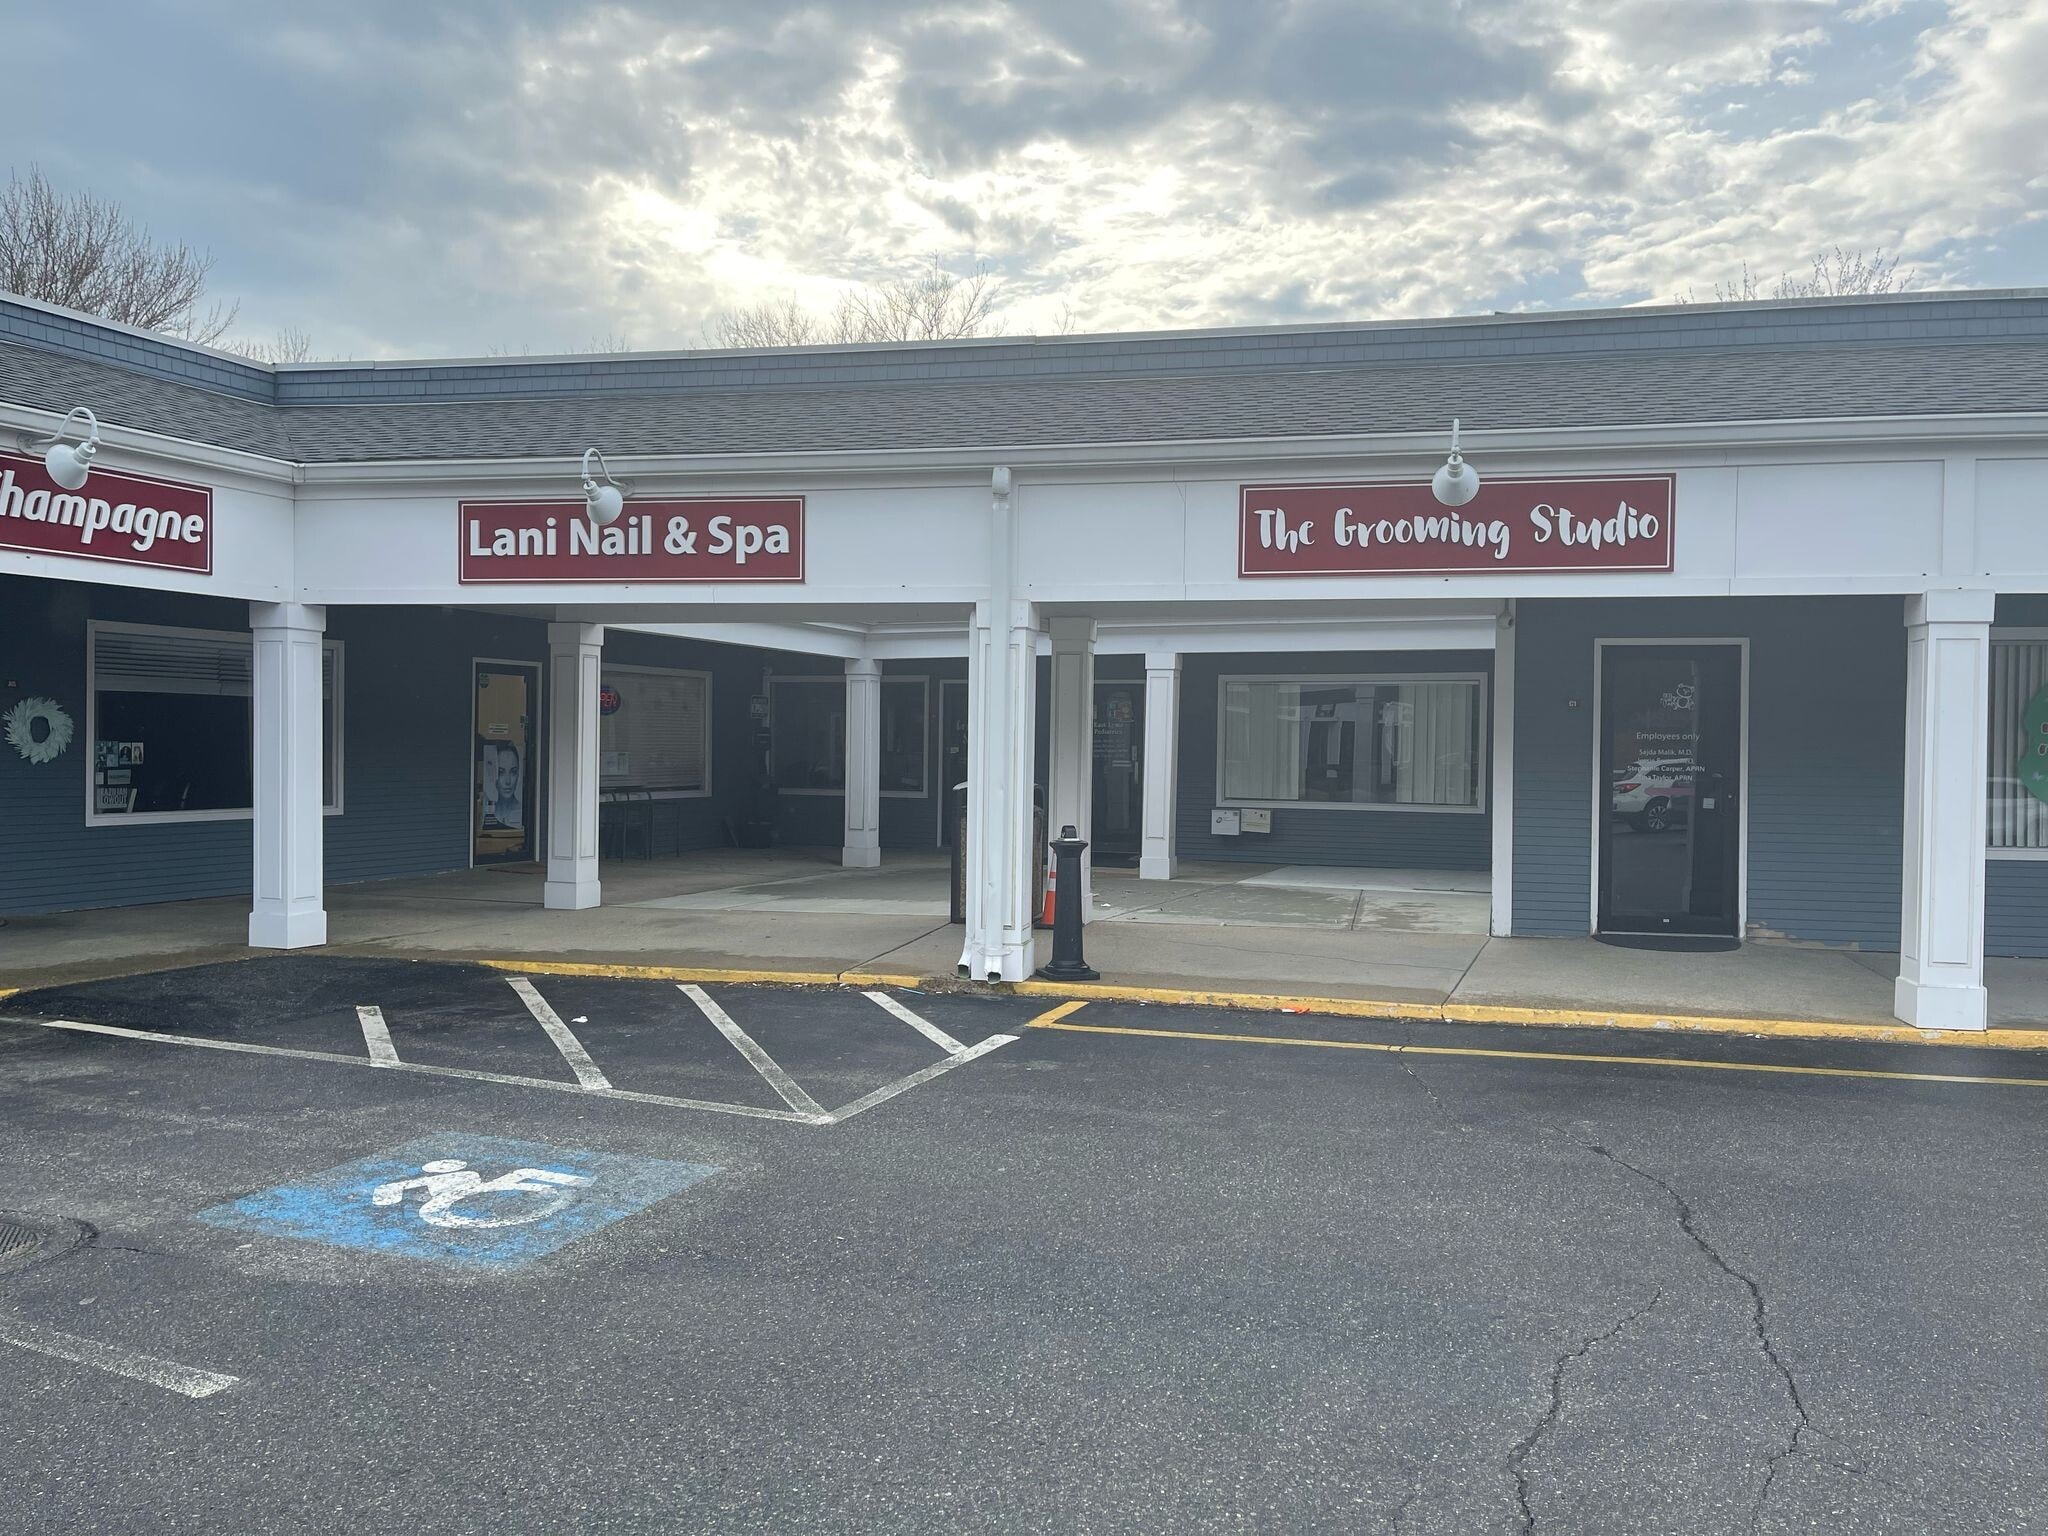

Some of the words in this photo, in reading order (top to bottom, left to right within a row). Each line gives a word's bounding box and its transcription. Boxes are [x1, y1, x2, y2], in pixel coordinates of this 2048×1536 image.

[0, 469, 204, 551] hampagne
[1254, 508, 1315, 554] The
[1334, 507, 1510, 560] Grooming
[1530, 500, 1659, 550] Studio
[469, 517, 557, 557] Lani
[569, 515, 652, 556] Nail
[663, 516, 697, 555] &
[707, 515, 790, 564] Spa
[600, 692, 619, 707] PEN
[1636, 731, 1680, 741] Employees
[1682, 732, 1701, 742] only
